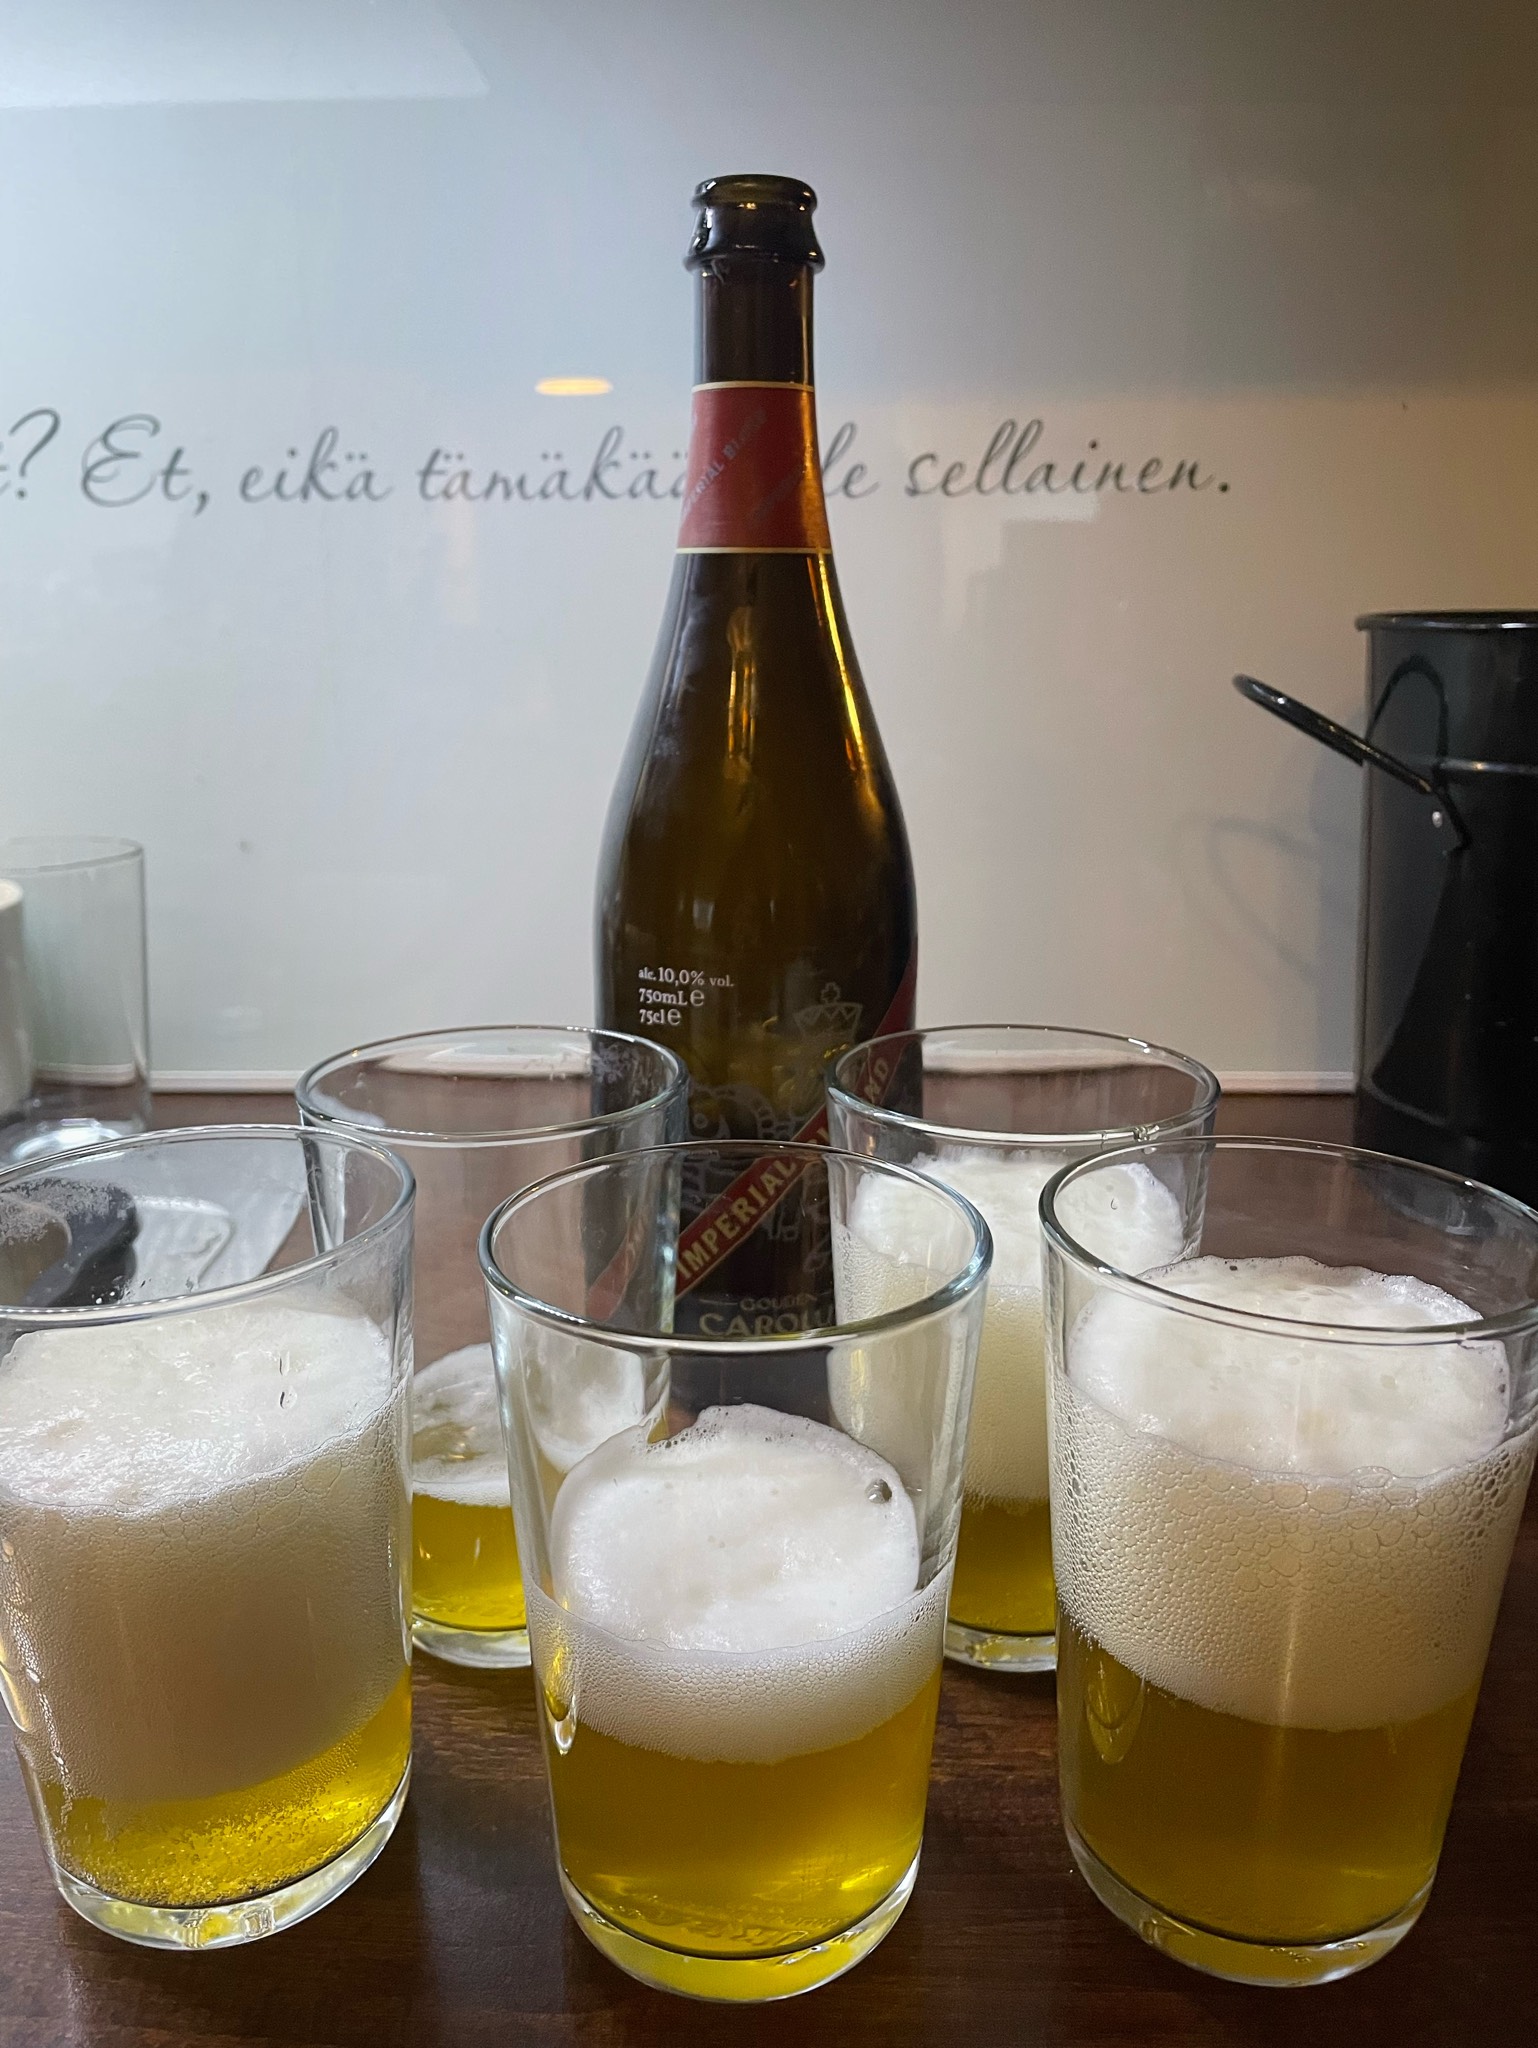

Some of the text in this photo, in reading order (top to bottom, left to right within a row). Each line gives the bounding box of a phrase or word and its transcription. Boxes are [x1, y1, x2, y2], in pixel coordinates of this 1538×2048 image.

[80, 412, 212, 517] Et,
[240, 425, 391, 503] eikä
[417, 425, 690, 503] tämäkää
[820, 421, 878, 500] le
[905, 418, 1234, 500] sellainen.
[638, 966, 735, 988] alc. 10,0% vol.
[638, 987, 688, 1007] 750mL
[638, 1008, 666, 1026] 75cl
[676, 1160, 797, 1279] IMPERIAL
